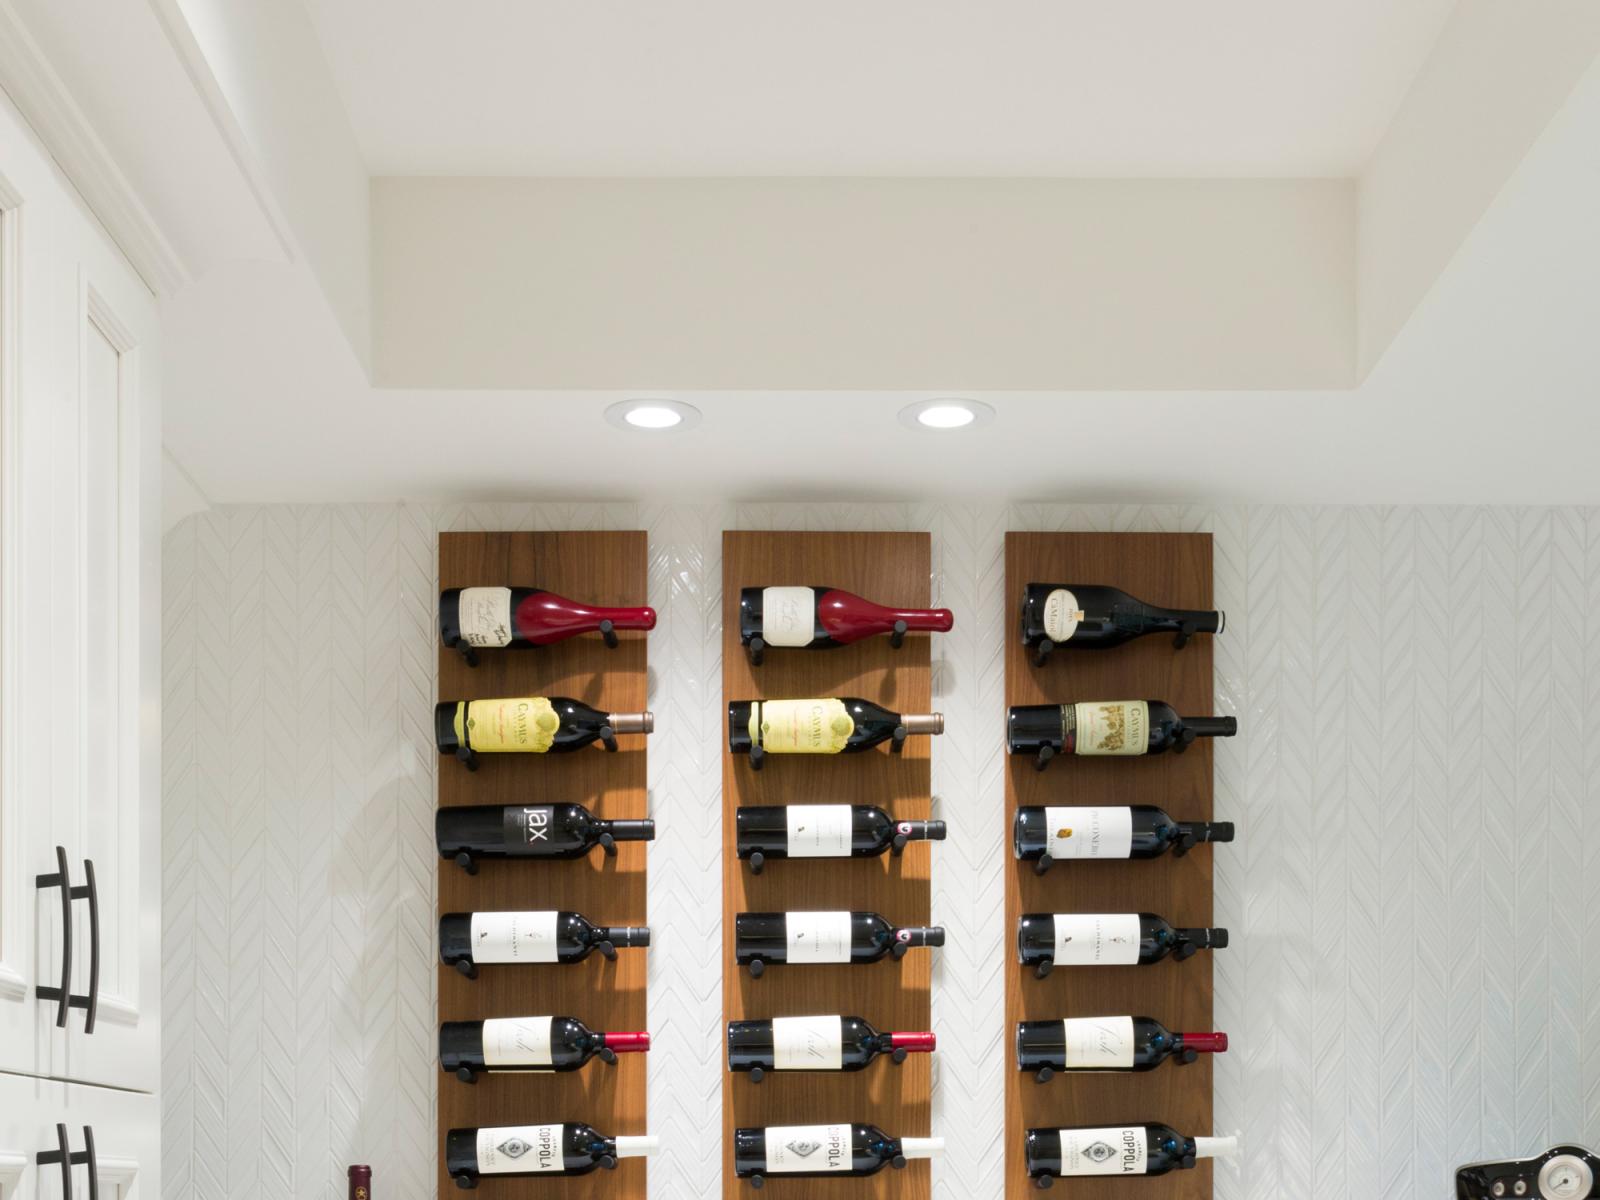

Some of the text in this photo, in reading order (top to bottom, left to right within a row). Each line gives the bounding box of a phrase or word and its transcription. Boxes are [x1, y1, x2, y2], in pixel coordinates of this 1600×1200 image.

[518, 703, 529, 745] CAYMUS
[812, 705, 824, 748] CAYMUS
[1131, 707, 1141, 746] CAYMUS
[539, 1127, 552, 1169] COPPOLA
[827, 1127, 841, 1168] COPPOLA
[1122, 1130, 1136, 1173] COPPOLA
